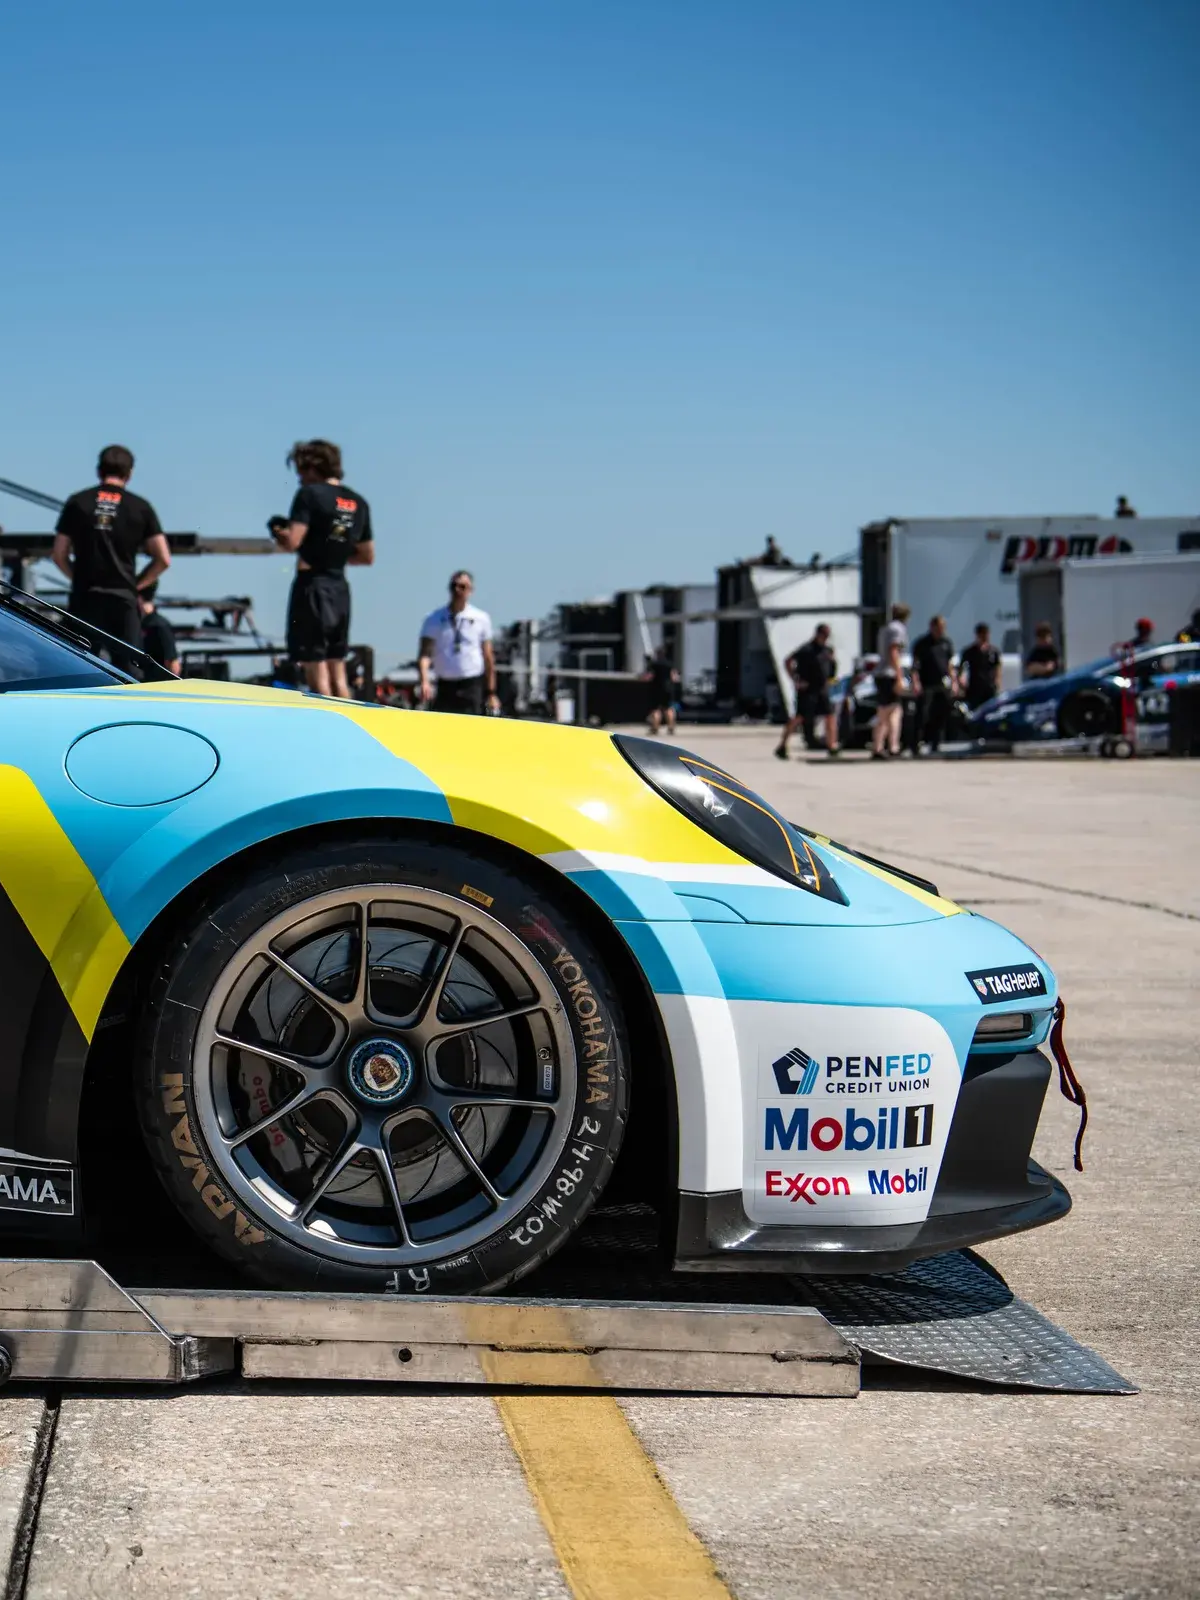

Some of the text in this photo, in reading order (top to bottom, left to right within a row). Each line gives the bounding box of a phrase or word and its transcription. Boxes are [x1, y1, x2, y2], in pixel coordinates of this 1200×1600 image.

[551, 948, 612, 1104] YOKOHAMA
[825, 1078, 931, 1094] CREDIT UNION
[826, 1053, 931, 1079] PENFED
[252, 1076, 287, 1147] brmbo
[764, 1106, 899, 1151] Mobil
[160, 1073, 266, 1245] ADVAN
[765, 1167, 928, 1205] Exxon Mobil
